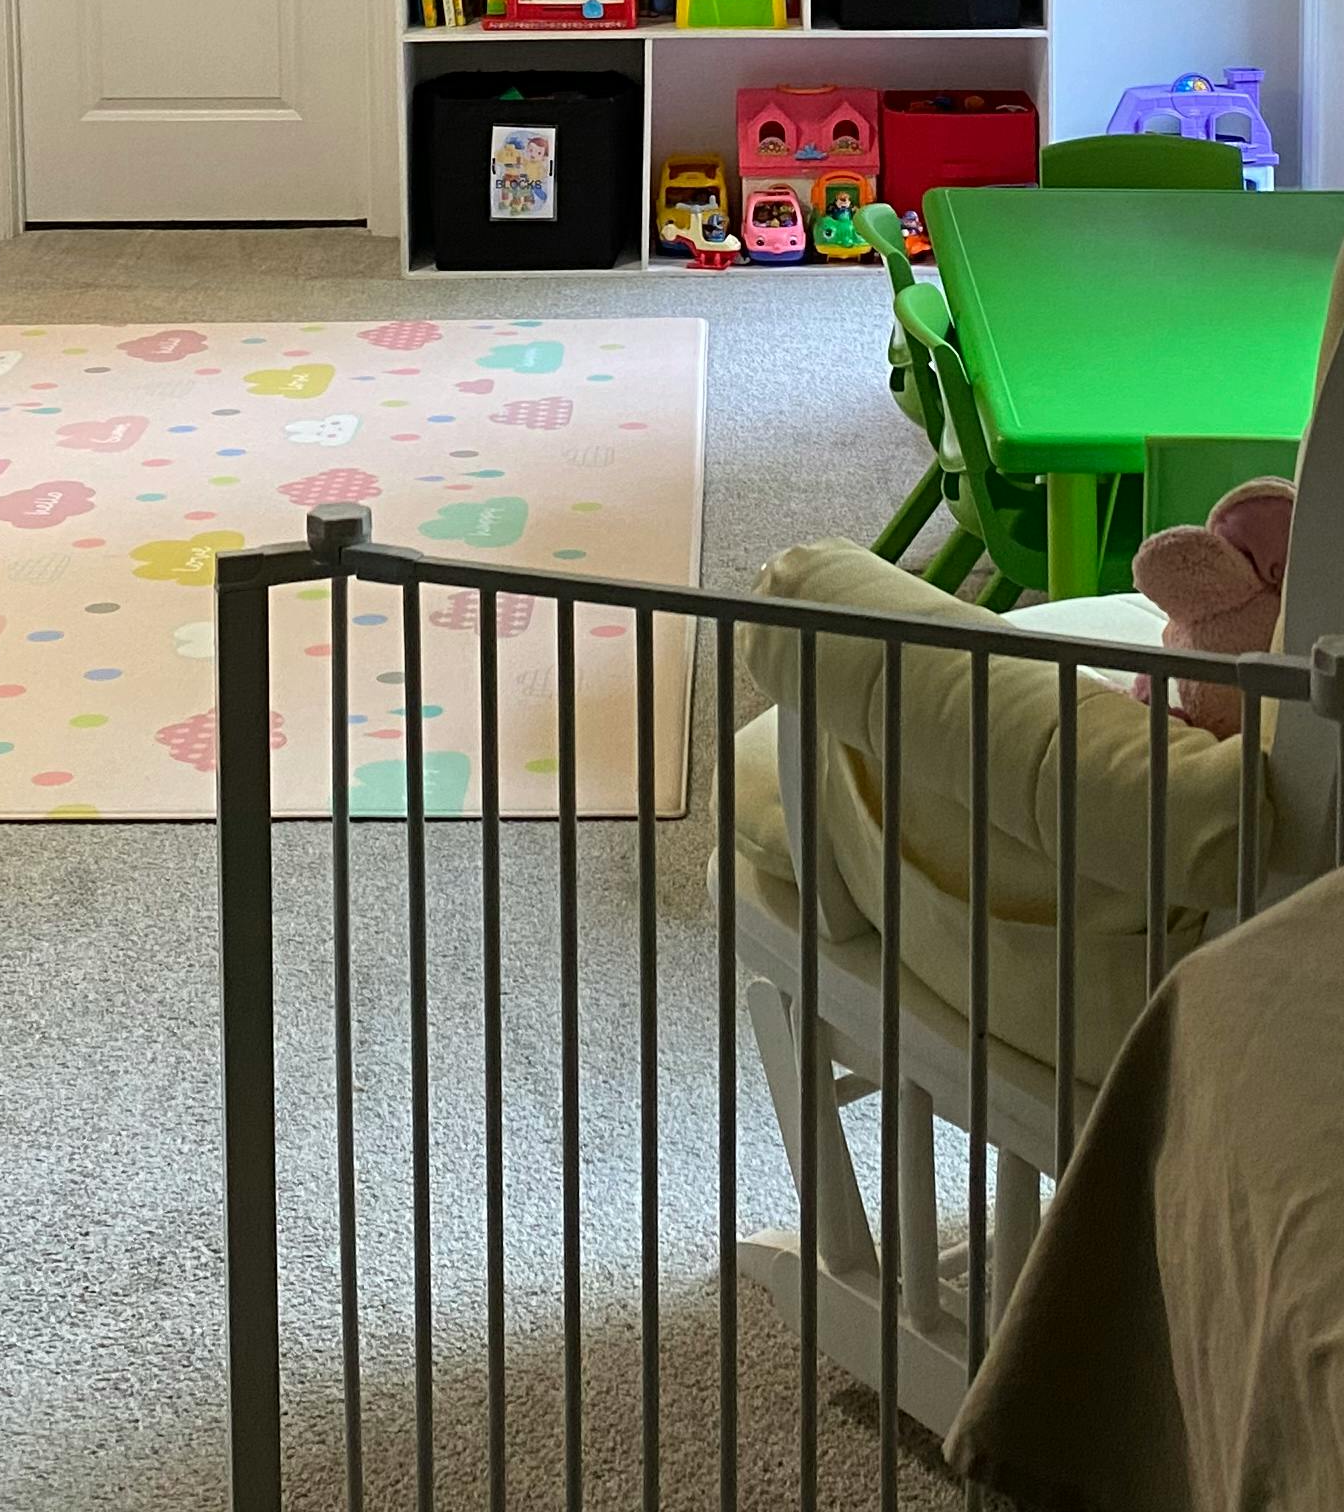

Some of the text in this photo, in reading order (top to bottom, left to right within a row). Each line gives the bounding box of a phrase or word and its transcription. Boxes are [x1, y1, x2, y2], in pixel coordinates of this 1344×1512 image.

[496, 180, 543, 190] BLOCKS
[24, 491, 63, 516] hello
[171, 546, 212, 572] love
